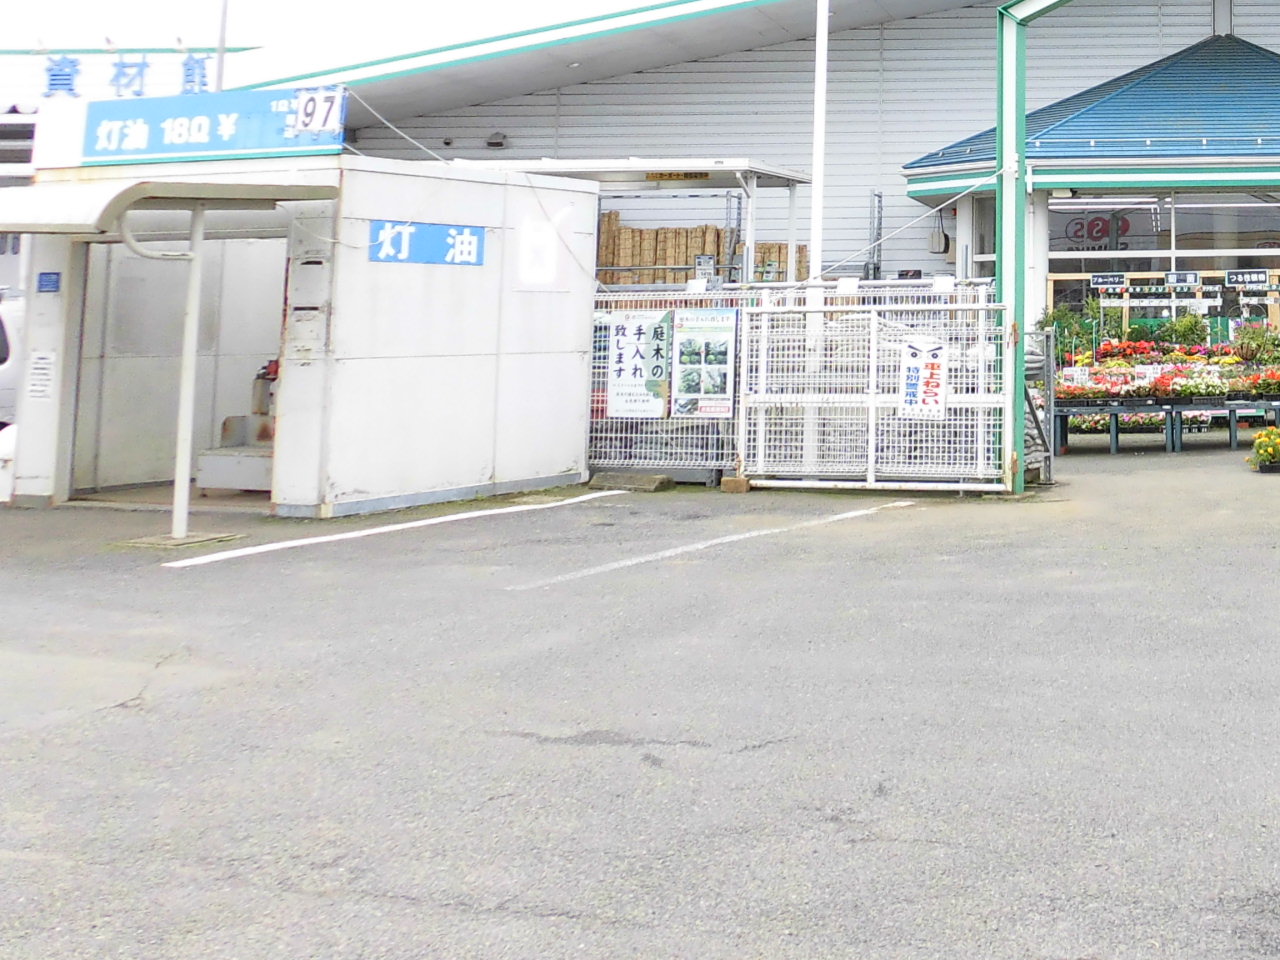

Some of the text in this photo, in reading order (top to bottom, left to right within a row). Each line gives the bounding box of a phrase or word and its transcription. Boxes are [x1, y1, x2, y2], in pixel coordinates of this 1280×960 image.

[301, 96, 336, 129] 97
[95, 118, 149, 151] 灯油
[377, 222, 479, 263] 灯油
[613, 324, 628, 378] 致します
[632, 324, 646, 378] 手入れ
[652, 325, 666, 379] 庭木の
[904, 366, 920, 406] 特別警戒中
[922, 362, 942, 406] 車上ねらい
